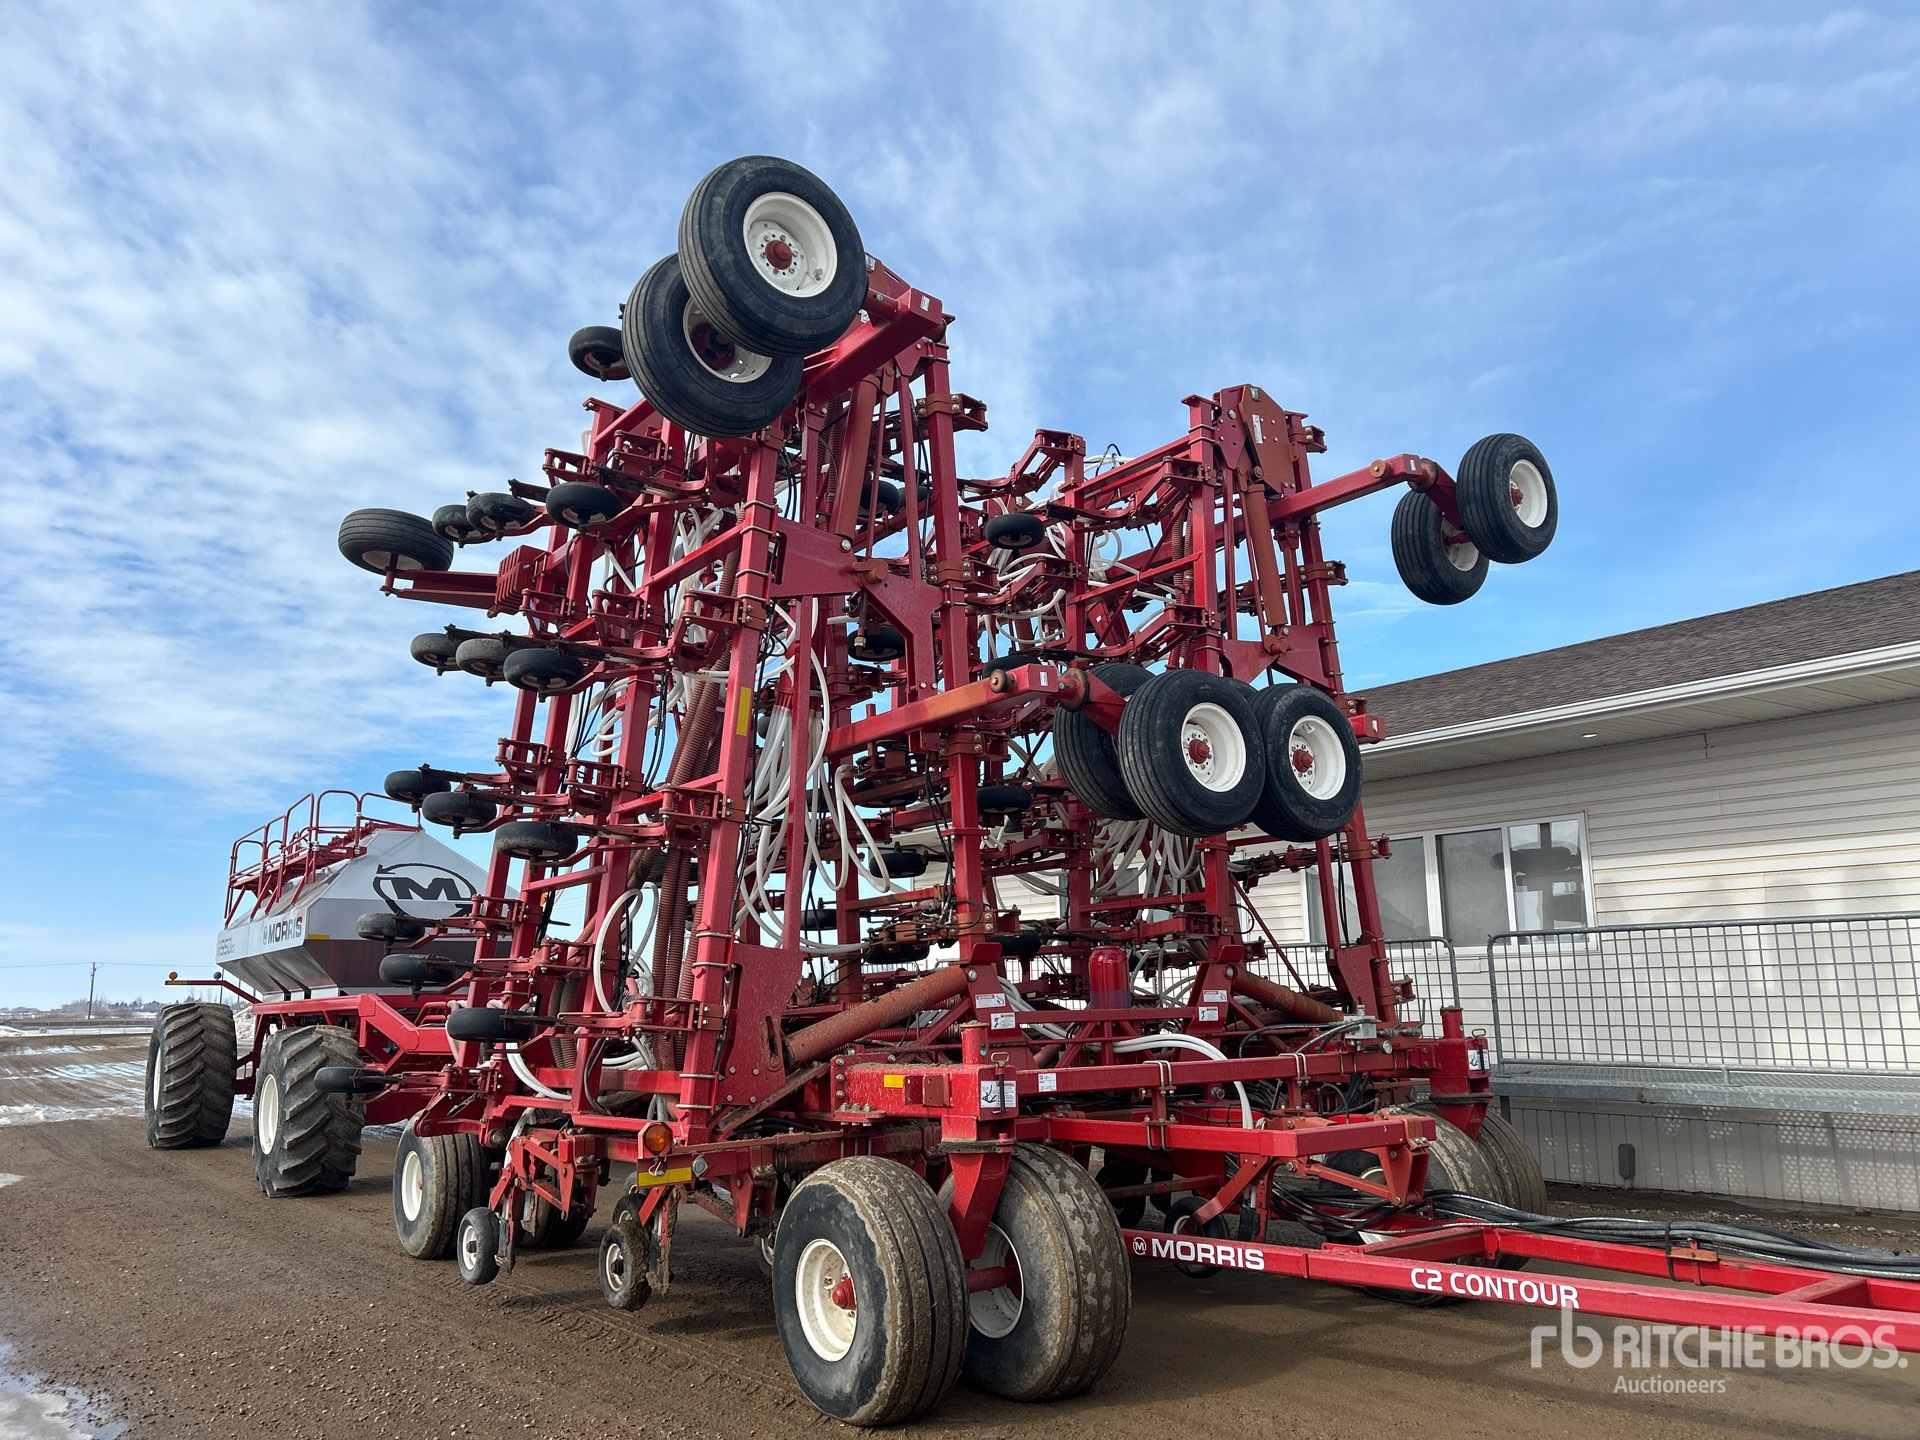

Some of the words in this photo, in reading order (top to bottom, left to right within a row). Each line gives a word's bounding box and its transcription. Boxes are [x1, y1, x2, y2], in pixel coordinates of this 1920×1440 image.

[267, 916, 303, 945] MORRIS
[1151, 1238, 1265, 1271] MORRIS
[1411, 1268, 1443, 1292] C2
[1450, 1271, 1580, 1309] CONTOUR
